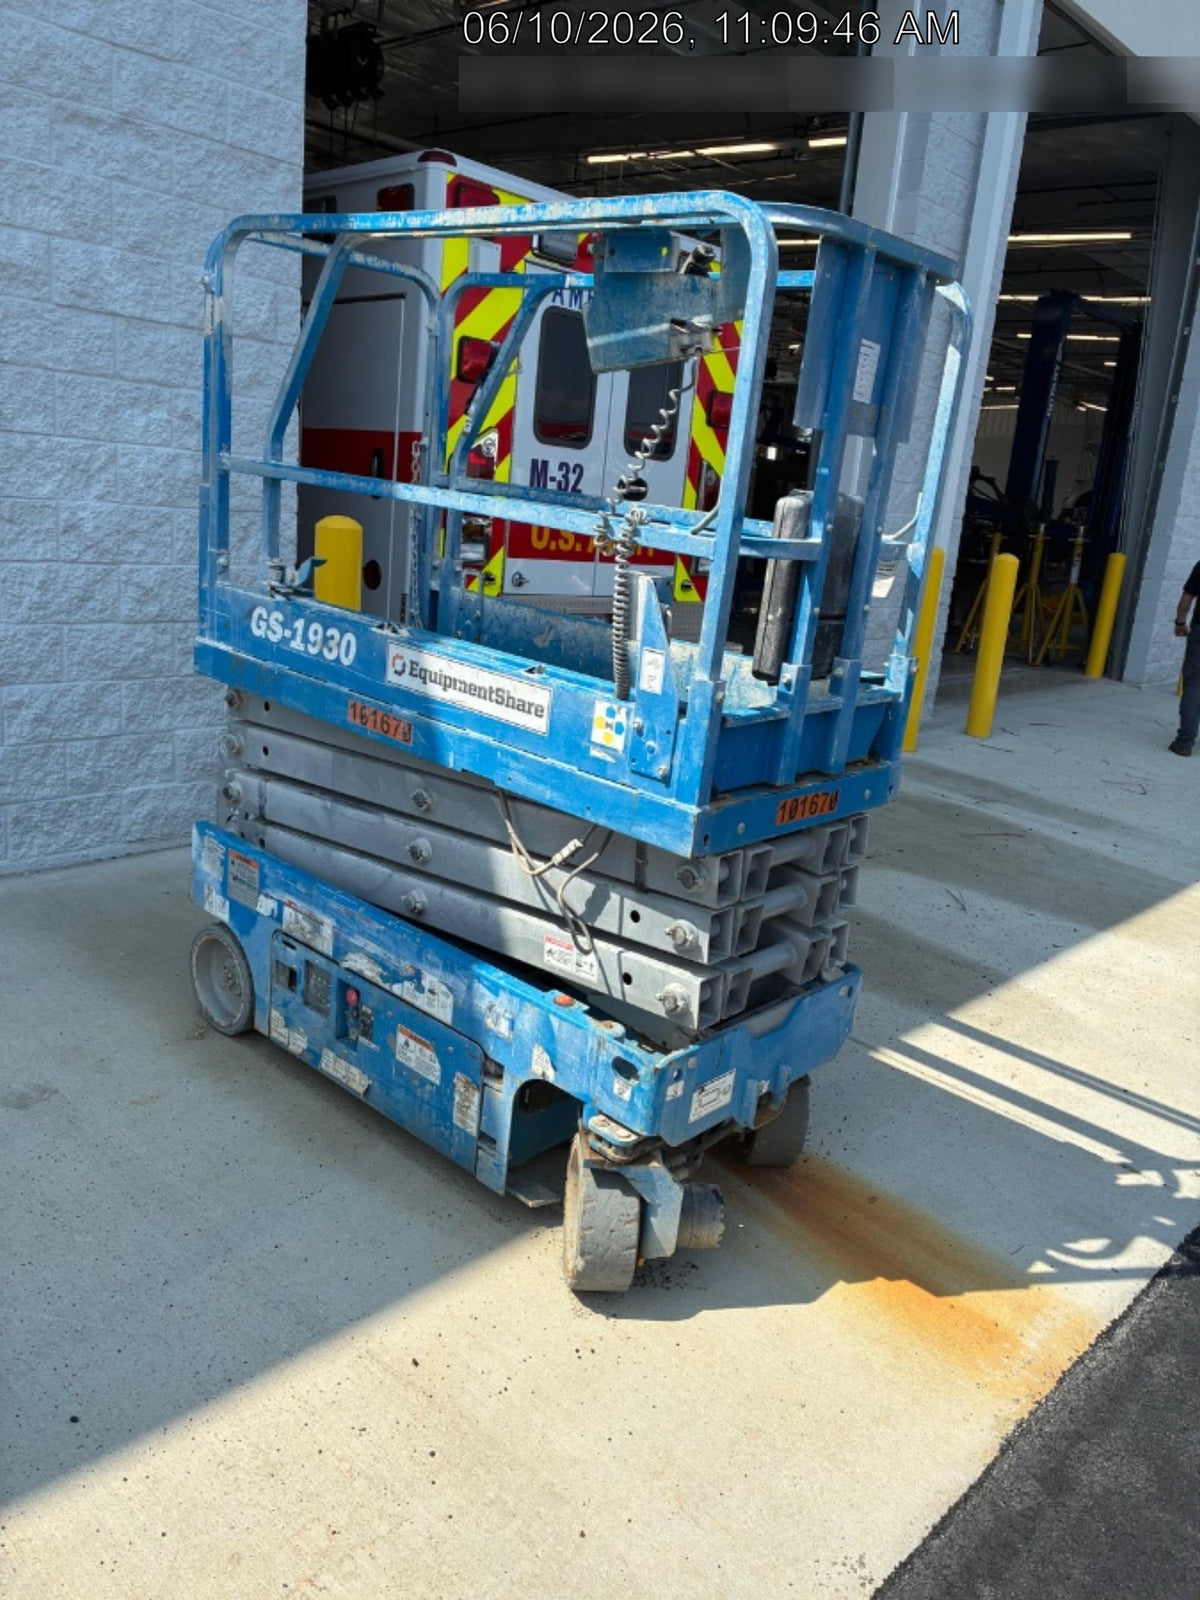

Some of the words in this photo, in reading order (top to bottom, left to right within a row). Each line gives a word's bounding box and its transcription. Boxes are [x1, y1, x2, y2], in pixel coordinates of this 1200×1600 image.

[529, 458, 584, 494] M-32
[250, 606, 357, 666] GS-1930
[406, 660, 546, 719] EquipmentShare
